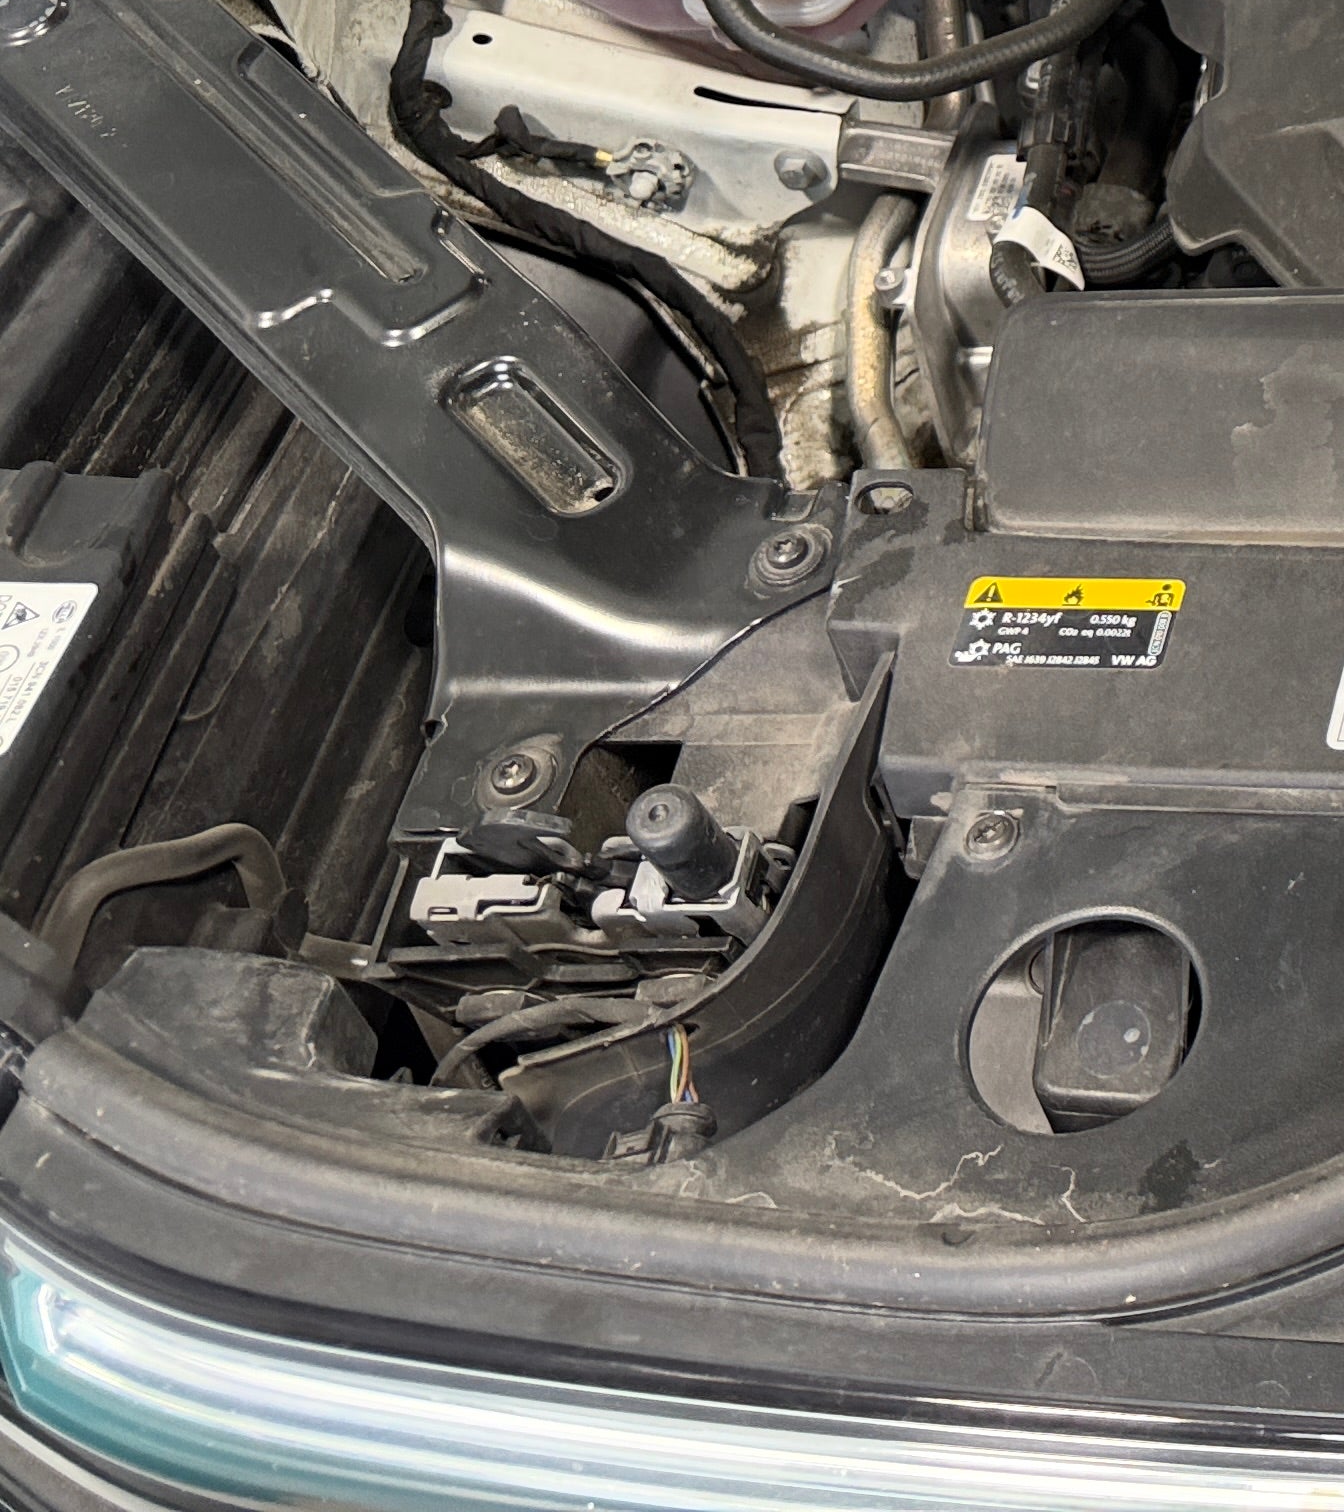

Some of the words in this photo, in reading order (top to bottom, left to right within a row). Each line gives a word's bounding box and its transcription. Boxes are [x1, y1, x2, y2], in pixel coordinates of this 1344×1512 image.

[1001, 611, 1063, 627] R-1234yf
[1089, 614, 1120, 625] 0.550
[1121, 615, 1138, 628] kg
[992, 642, 1022, 654] PAG
[1111, 654, 1135, 666] VW
[1135, 655, 1158, 666] AG
